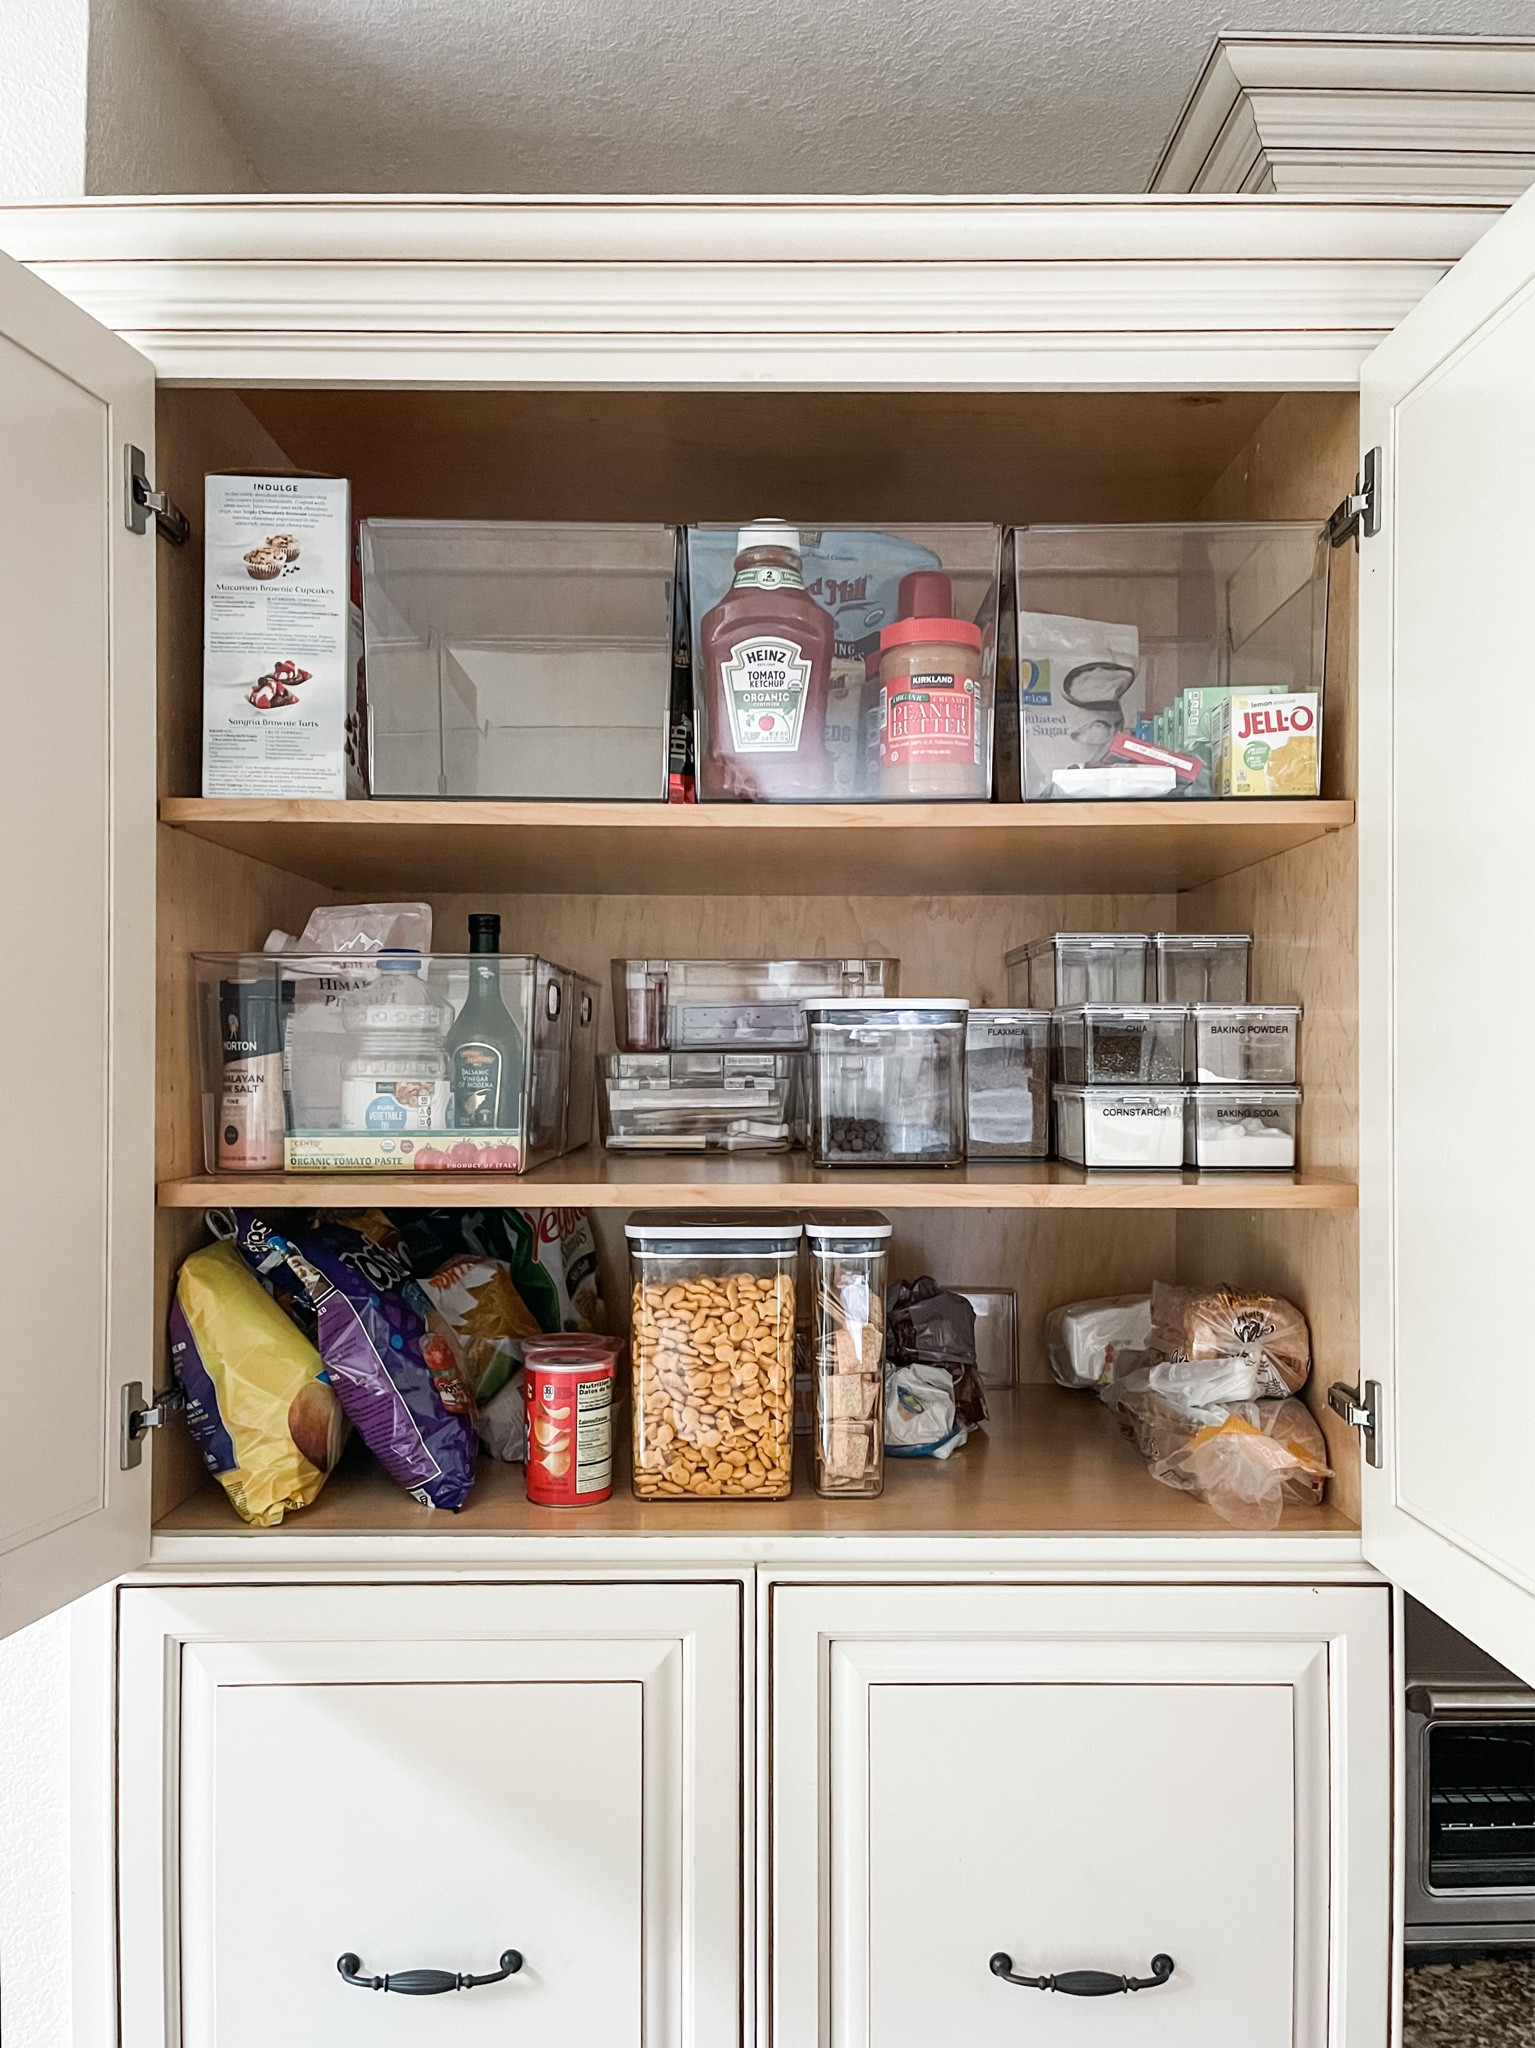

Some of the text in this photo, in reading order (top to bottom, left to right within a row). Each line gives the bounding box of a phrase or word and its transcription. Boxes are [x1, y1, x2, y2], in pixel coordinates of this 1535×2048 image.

[253, 483, 298, 492] INDULGE
[766, 571, 773, 579] 2
[216, 583, 335, 596] Macaroon Brownie Cupcakes
[824, 575, 868, 606] Mill
[746, 649, 787, 664] HEINZ
[747, 670, 786, 680] TOMATO
[912, 675, 953, 684] KIRKLAND
[749, 680, 785, 688] KETCHUP
[743, 692, 790, 702] ORGANIC
[893, 692, 922, 704] ORGANIC
[893, 703, 967, 722] PEANUT
[228, 718, 319, 729] Sangria Brownie Tarts
[893, 718, 967, 737] BUTTER
[1033, 725, 1069, 738] Sugar
[987, 1028, 1031, 1036] FLAXMEAL
[1125, 1025, 1148, 1033] CHIA
[1211, 1025, 1289, 1035] BAKING POWDER
[461, 1067, 490, 1076] BALSAMIC
[462, 1075, 489, 1083] VINEGAR
[234, 1084, 259, 1094] SALT
[368, 1111, 403, 1121] VEGETABLE
[1102, 1108, 1168, 1117] CORNSTARCH
[1217, 1109, 1280, 1118] BAKING SODA
[290, 1157, 403, 1166] ORGANIC TOMATO PASTE
